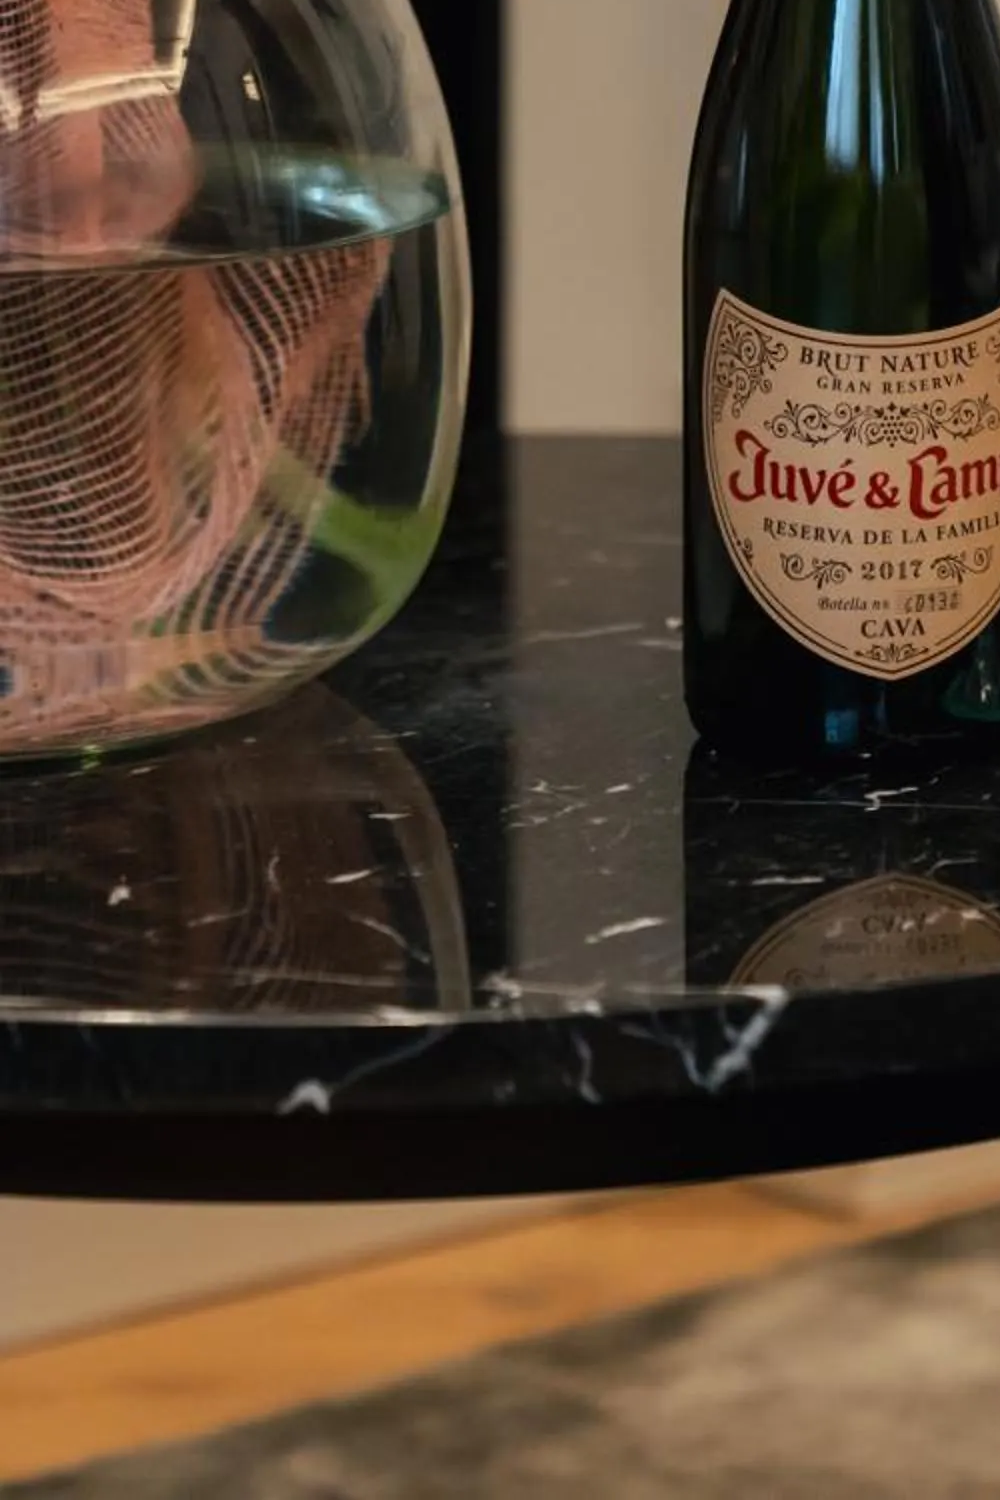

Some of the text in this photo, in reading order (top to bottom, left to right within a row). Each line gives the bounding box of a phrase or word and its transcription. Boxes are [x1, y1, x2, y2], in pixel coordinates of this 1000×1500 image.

[800, 341, 980, 376] BRUT NATURE
[817, 373, 965, 395] GRAN RESERVA
[729, 429, 856, 509] Juvé
[864, 471, 900, 509] &
[763, 517, 852, 545] RESERVA
[863, 530, 893, 545] DE
[902, 529, 928, 544] LA
[861, 560, 922, 580] 2017
[818, 596, 867, 611] Botella
[861, 617, 925, 639] CAVA
